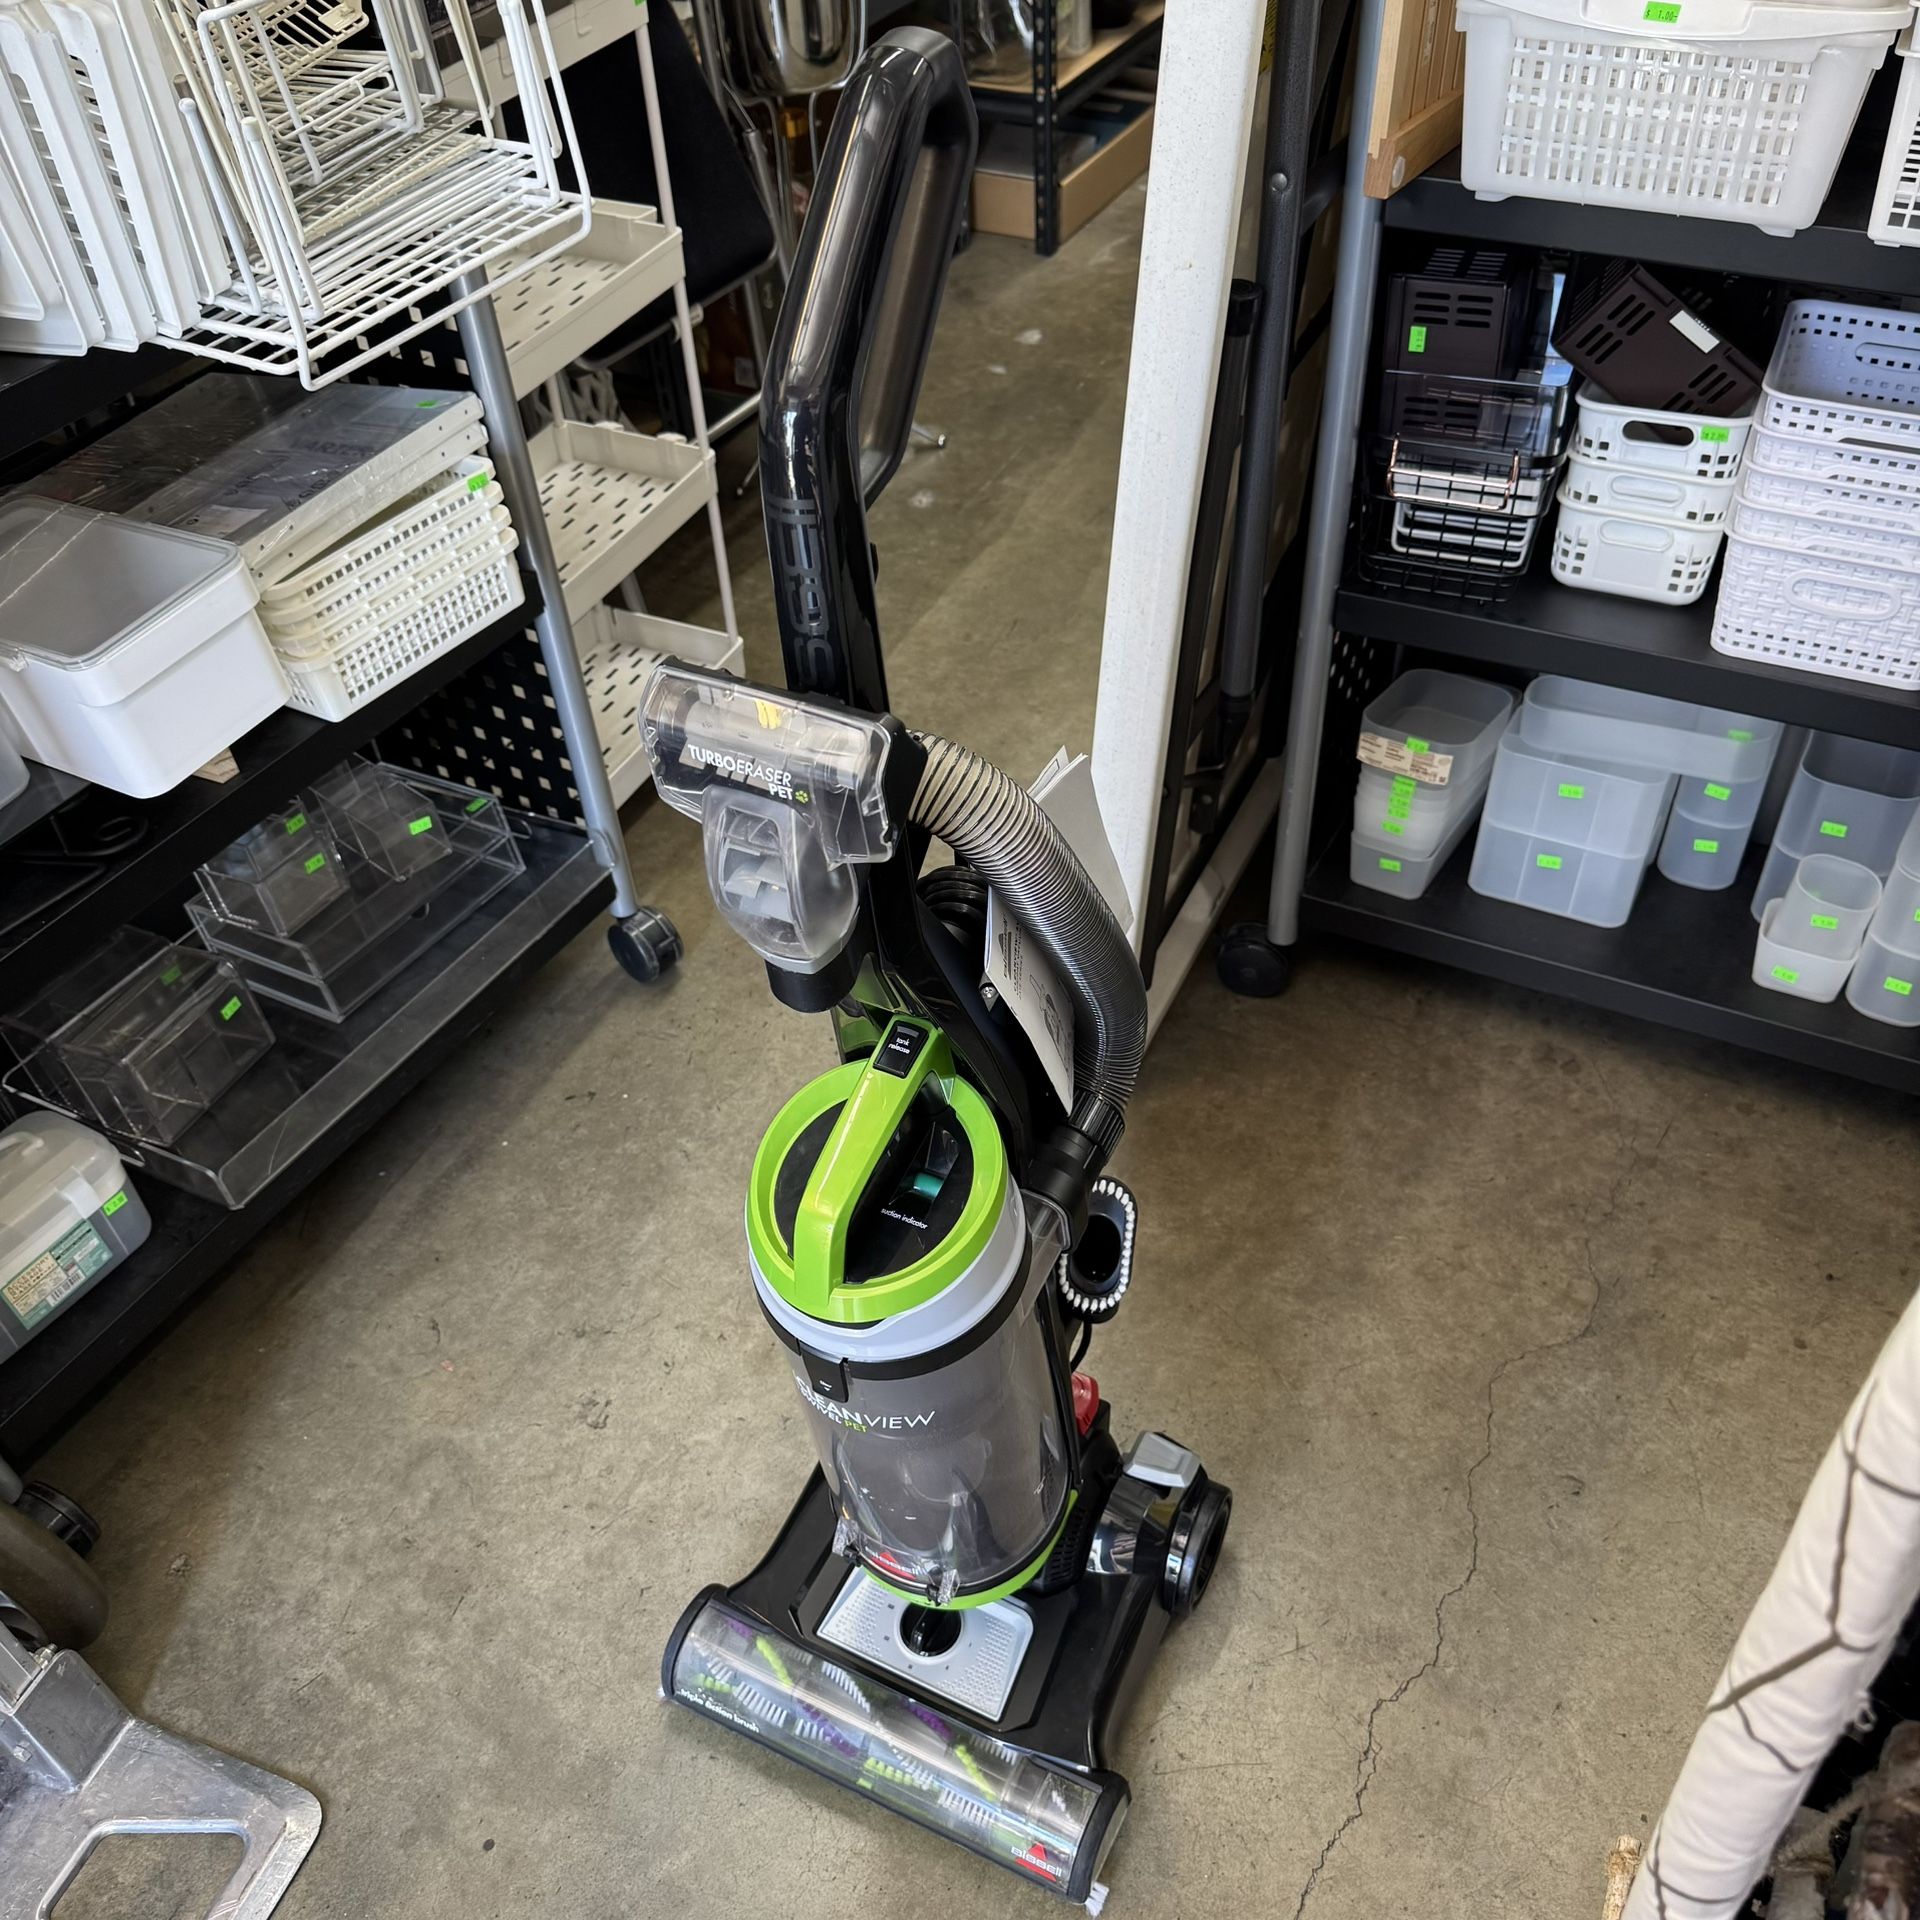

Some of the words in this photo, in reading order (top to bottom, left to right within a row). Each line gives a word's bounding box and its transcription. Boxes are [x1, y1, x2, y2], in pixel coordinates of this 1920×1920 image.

[688, 744, 792, 787] TURBOERASER
[768, 783, 793, 800] PET
[896, 1036, 910, 1046] tank
[888, 1043, 910, 1054] release
[880, 1208, 901, 1220] suction
[901, 1214, 928, 1229] indicator
[845, 1420, 868, 1432] PET
